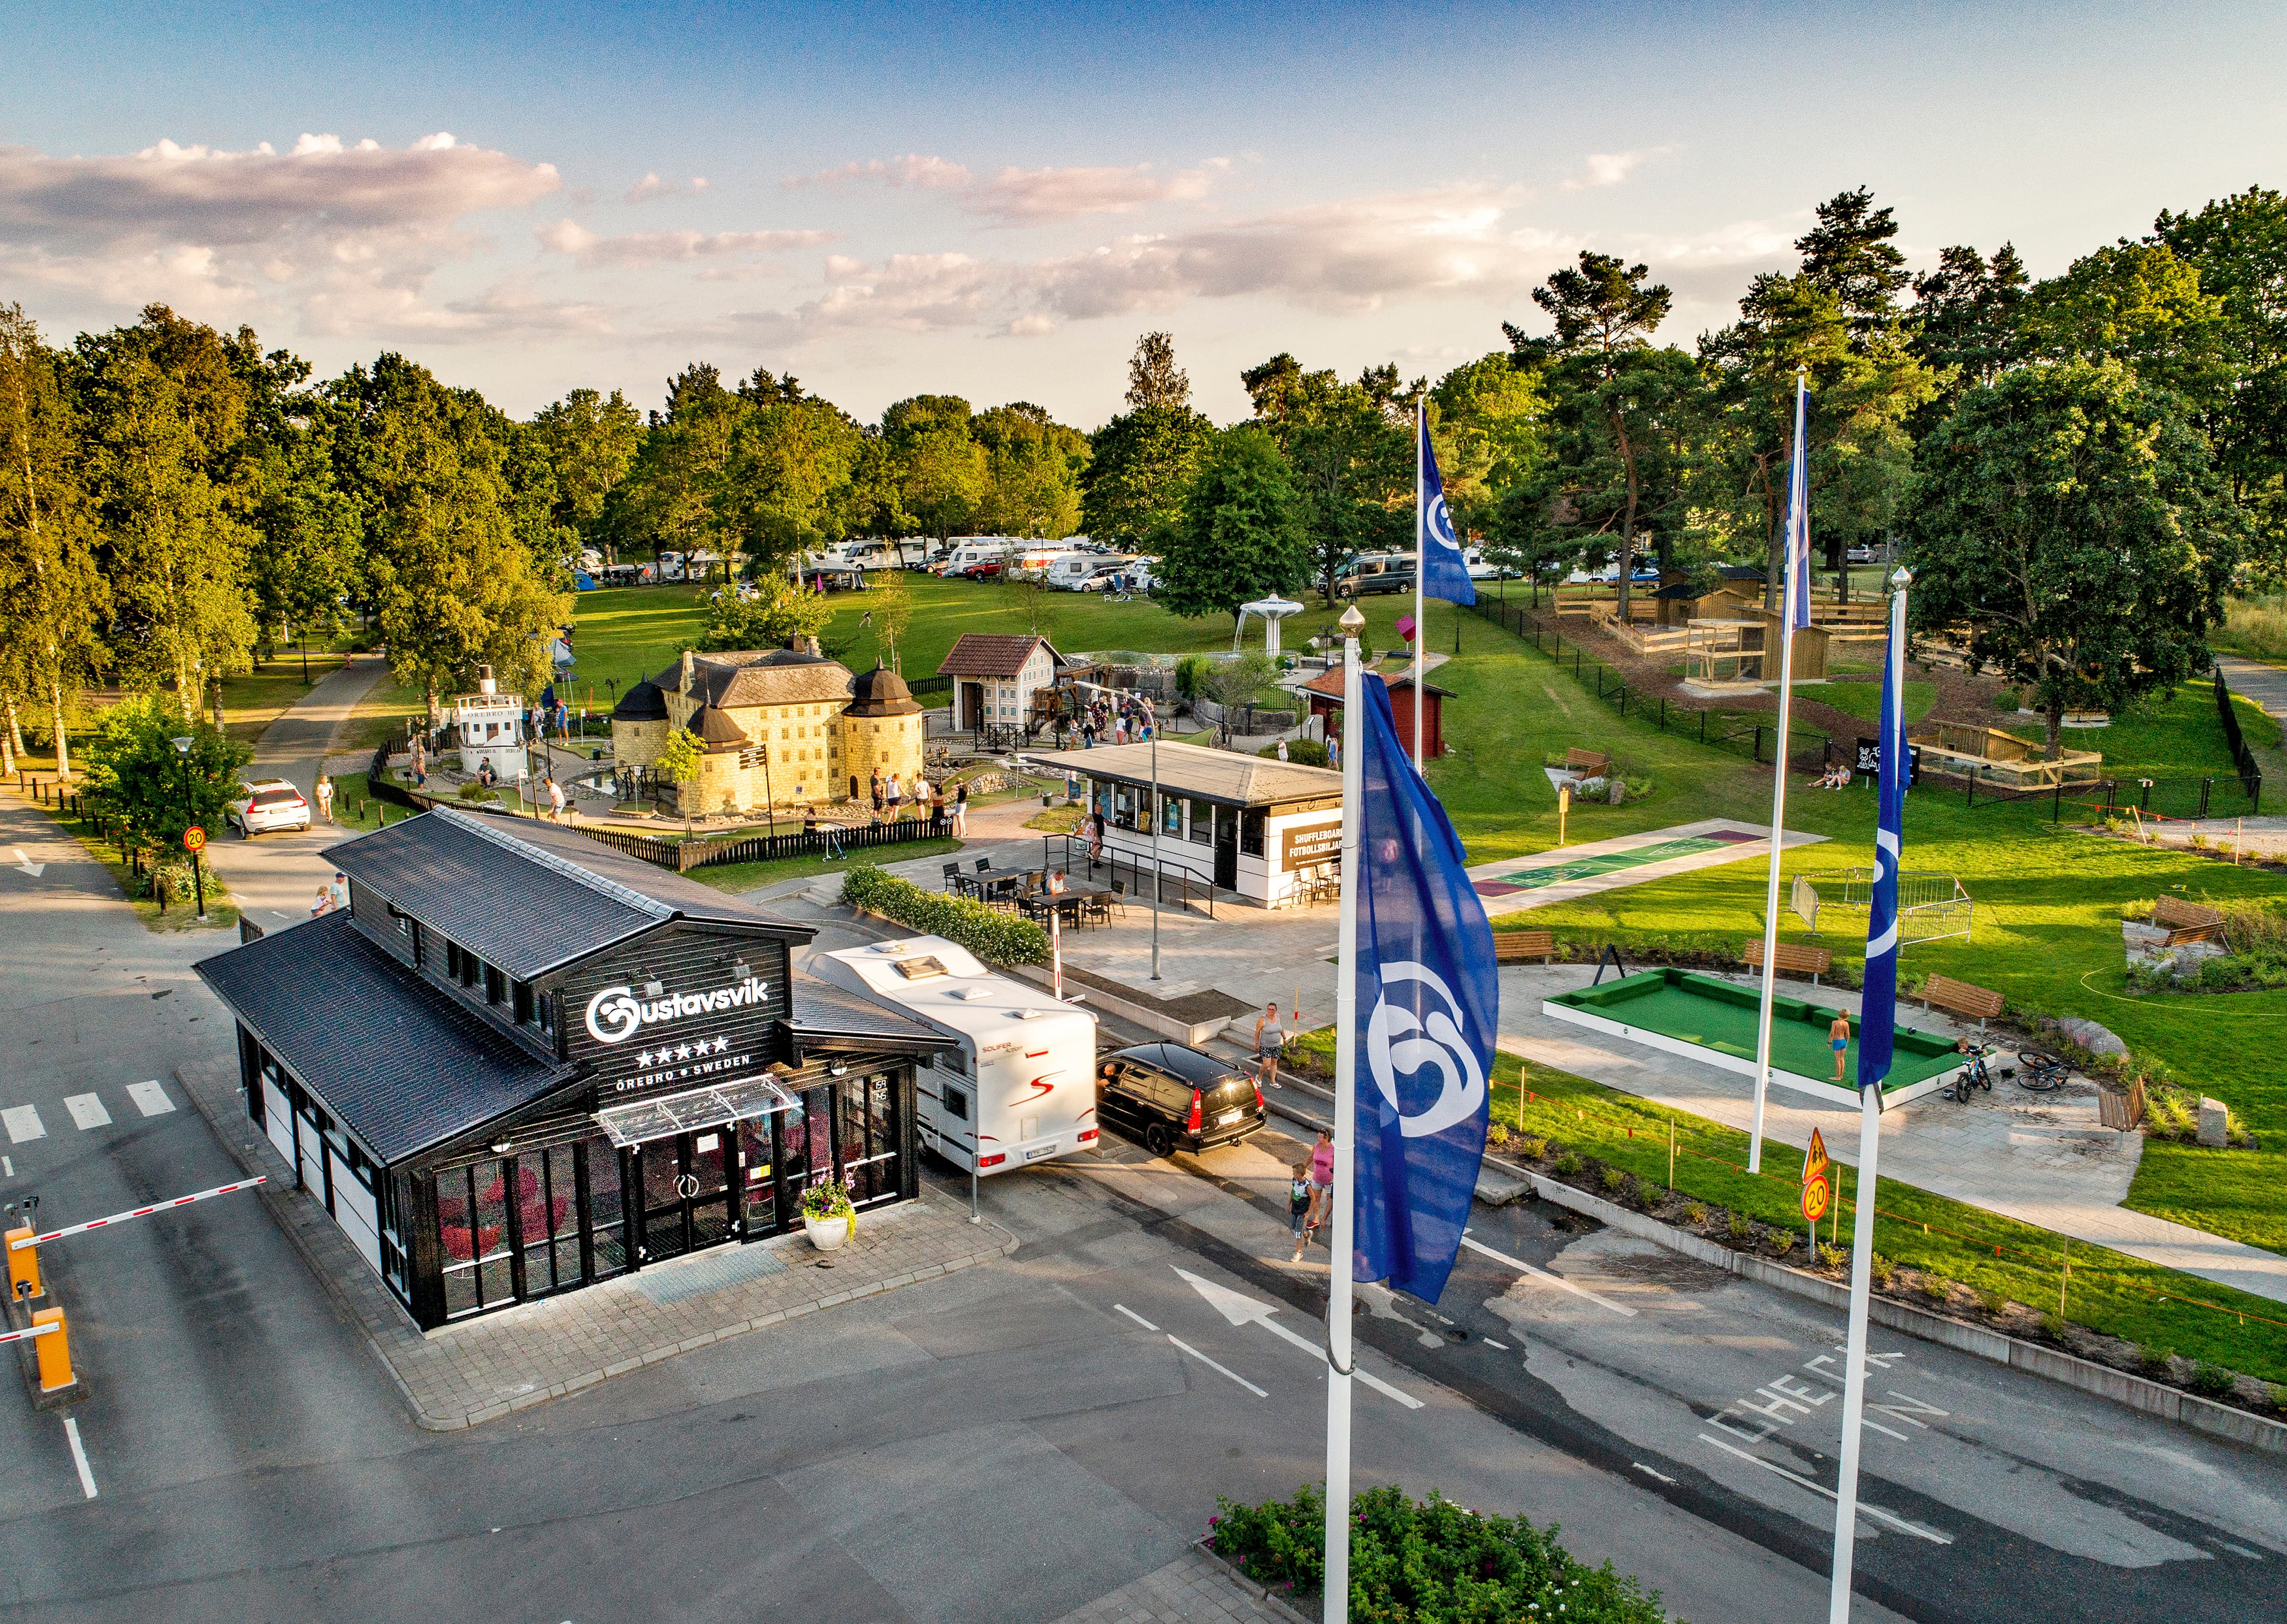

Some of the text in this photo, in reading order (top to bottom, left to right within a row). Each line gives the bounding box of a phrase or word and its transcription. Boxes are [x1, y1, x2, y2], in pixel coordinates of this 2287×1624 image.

[189, 833, 202, 845] 20
[1289, 840, 1342, 858] FOTBOLLSBILJAR
[585, 977, 768, 1043] Gustavsvik
[982, 1042, 1011, 1053] SOLIFER
[616, 1055, 750, 1091] ÖREBRO SWEDEN
[1809, 1185, 1824, 1211] 20
[1861, 1391, 1950, 1441] IN
